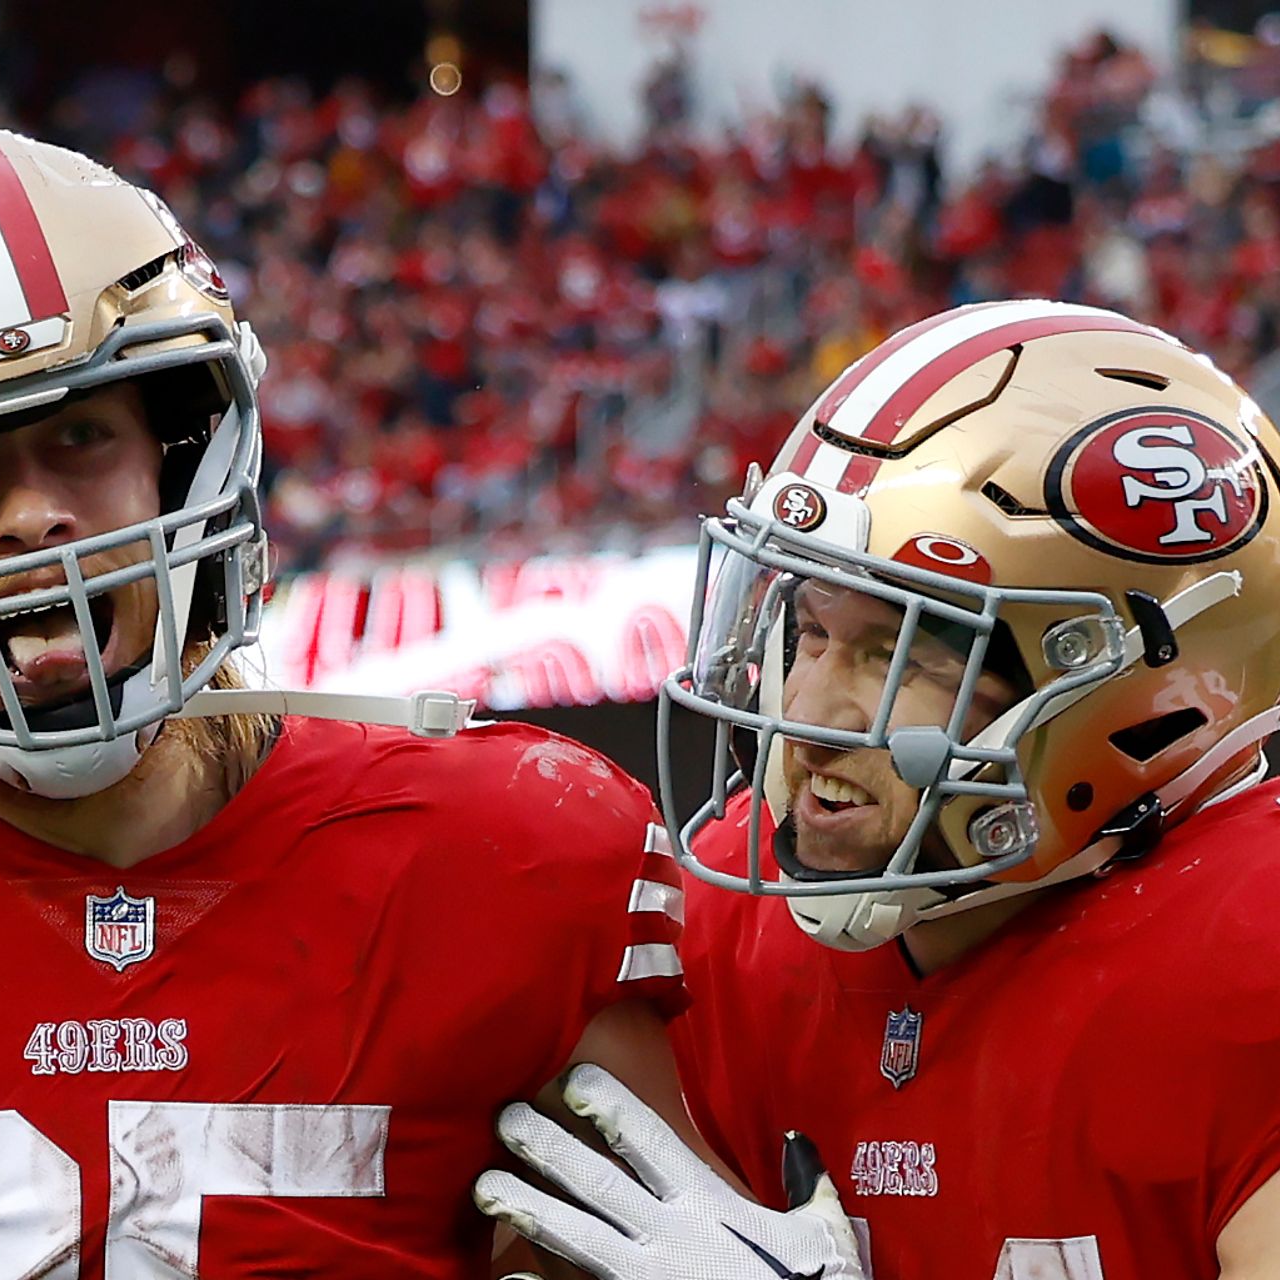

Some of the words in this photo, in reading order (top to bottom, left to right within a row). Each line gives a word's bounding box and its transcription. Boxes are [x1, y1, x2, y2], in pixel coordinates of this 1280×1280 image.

[778, 485, 814, 527] SF
[1112, 424, 1260, 546] SF
[96, 923, 144, 955] NFL
[24, 1018, 189, 1076] 49ERS
[850, 1141, 939, 1197] 49ERS
